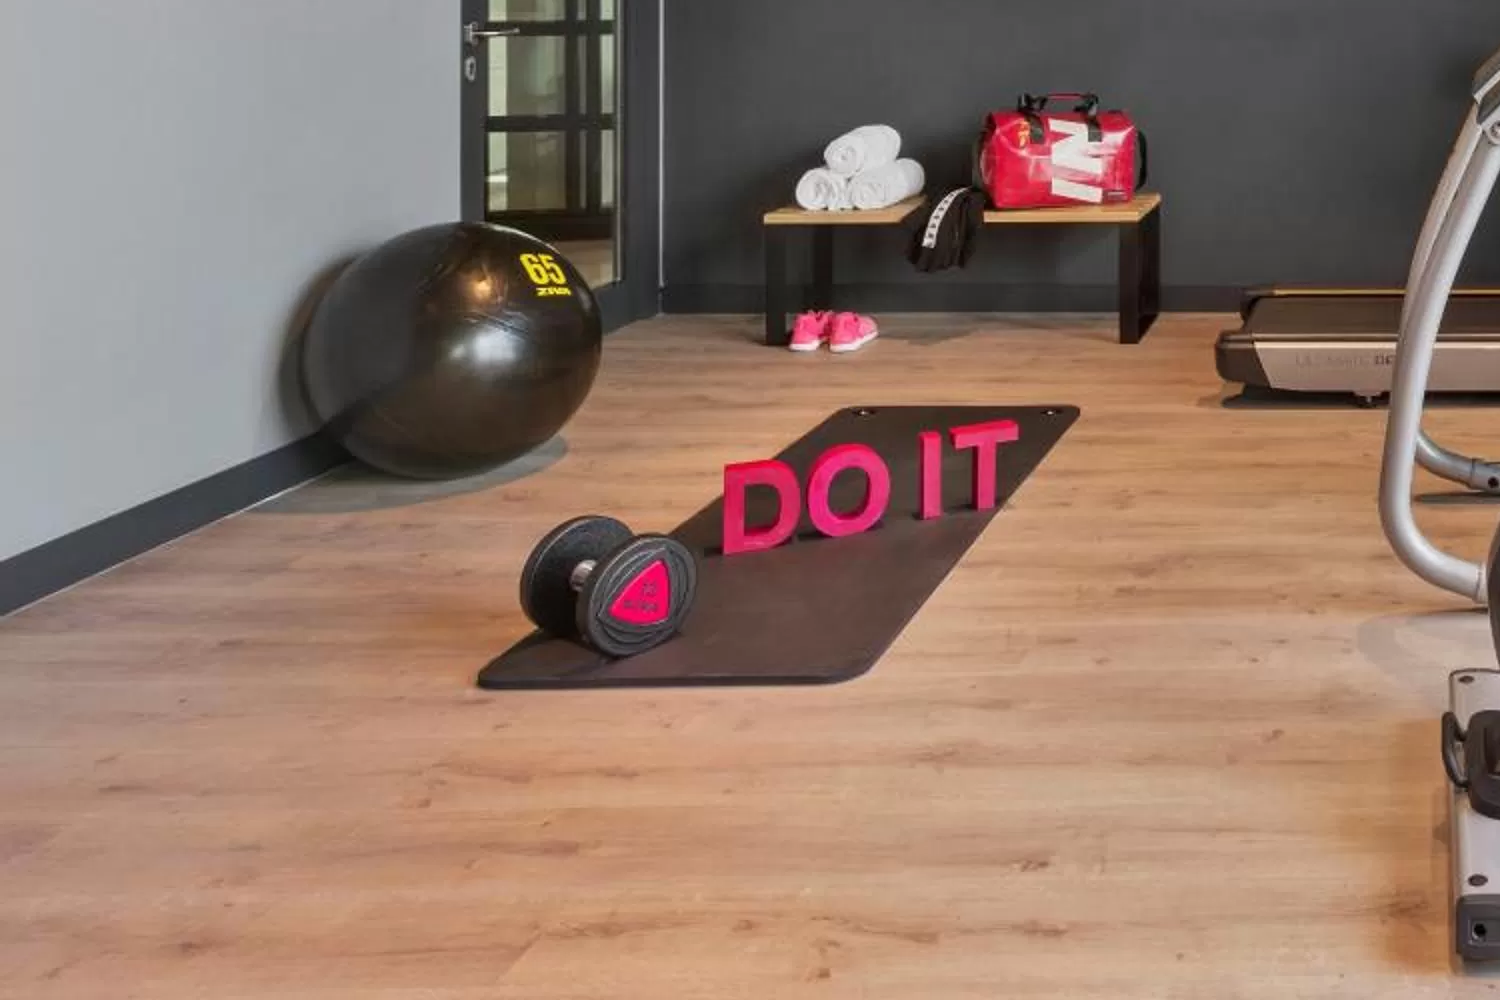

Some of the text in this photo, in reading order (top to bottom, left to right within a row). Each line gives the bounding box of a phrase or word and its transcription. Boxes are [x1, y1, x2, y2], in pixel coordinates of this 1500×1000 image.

[520, 253, 566, 284] 65
[723, 419, 1018, 556] DO IT
